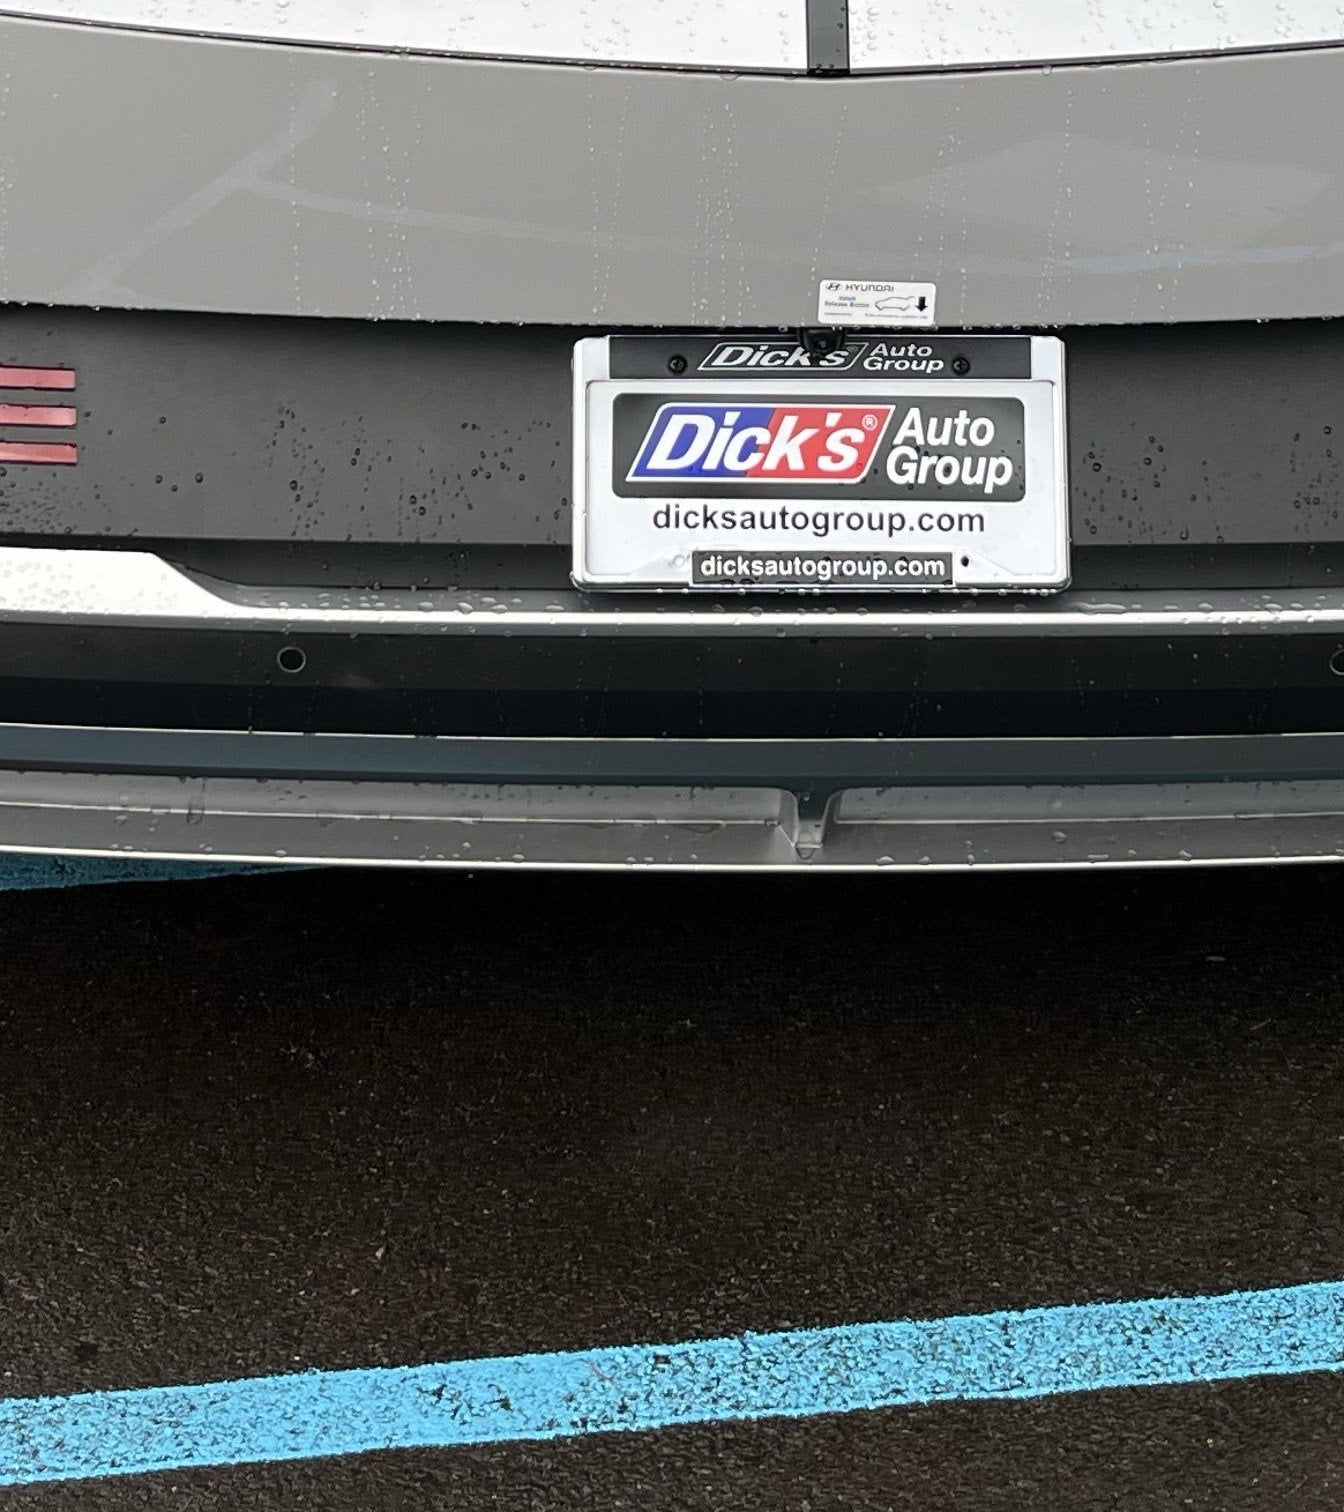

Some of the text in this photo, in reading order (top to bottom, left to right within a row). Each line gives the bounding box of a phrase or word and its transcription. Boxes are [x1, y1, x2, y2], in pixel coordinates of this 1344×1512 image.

[711, 345, 850, 367] Dicks
[869, 342, 934, 357] Auto
[863, 356, 945, 374] Group
[893, 407, 996, 447] Auto
[885, 446, 1014, 494] Group
[652, 504, 986, 537] dicksautogroup.com
[699, 554, 946, 579] dicksautogroup.com
